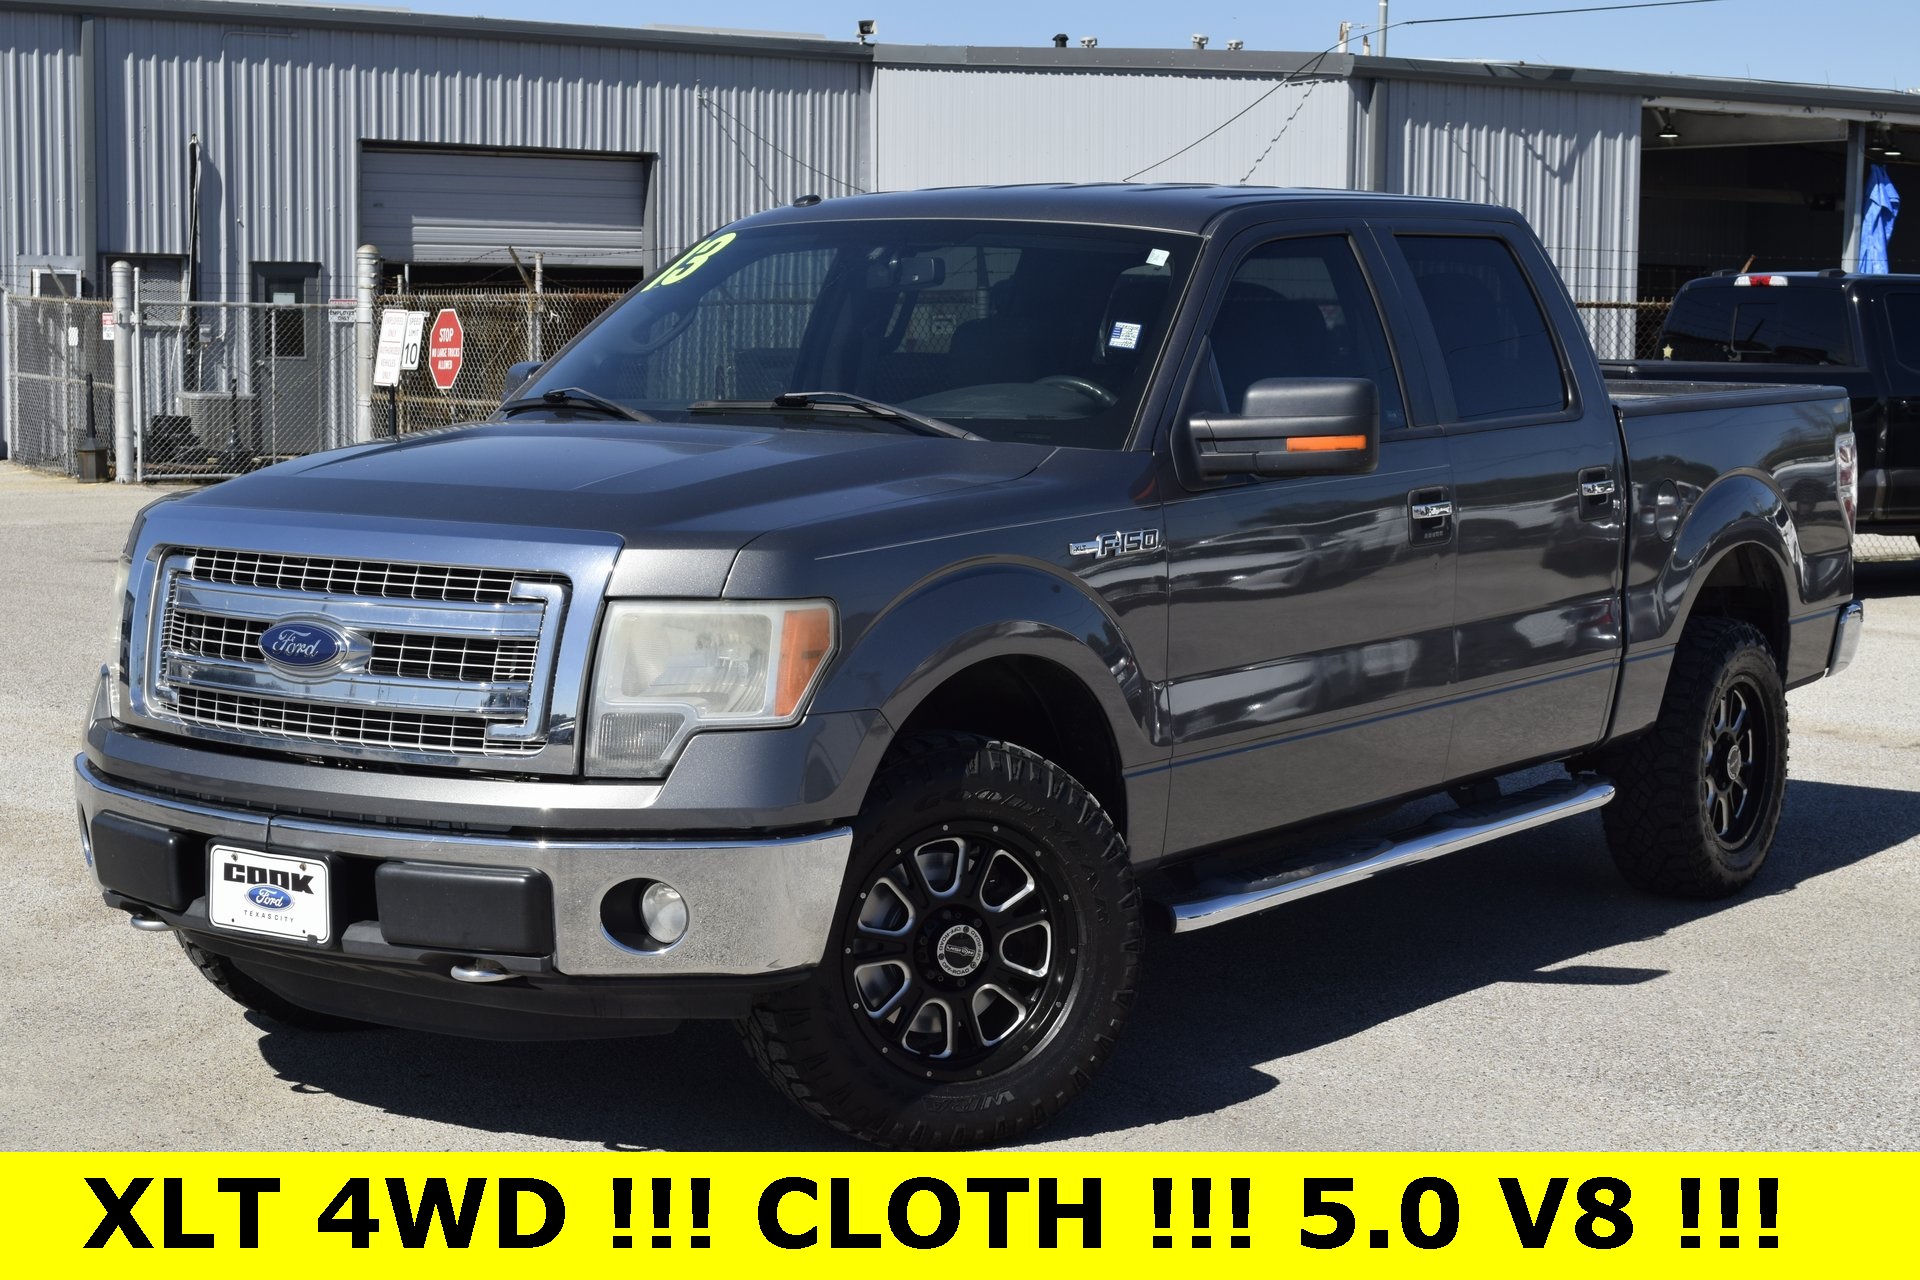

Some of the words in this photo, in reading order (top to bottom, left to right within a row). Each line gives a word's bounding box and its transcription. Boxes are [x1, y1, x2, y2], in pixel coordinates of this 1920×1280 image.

[641, 232, 737, 293] 13
[409, 317, 422, 326] SPEED
[408, 328, 420, 337] LIMIT
[439, 327, 455, 343] STOP
[405, 342, 418, 365] 10
[437, 347, 447, 357] LARGE
[447, 347, 460, 357] TRUCKS
[437, 360, 453, 370] ALLOWED
[272, 629, 321, 658] Ford
[223, 862, 315, 895] COOK
[255, 887, 284, 907] Ford
